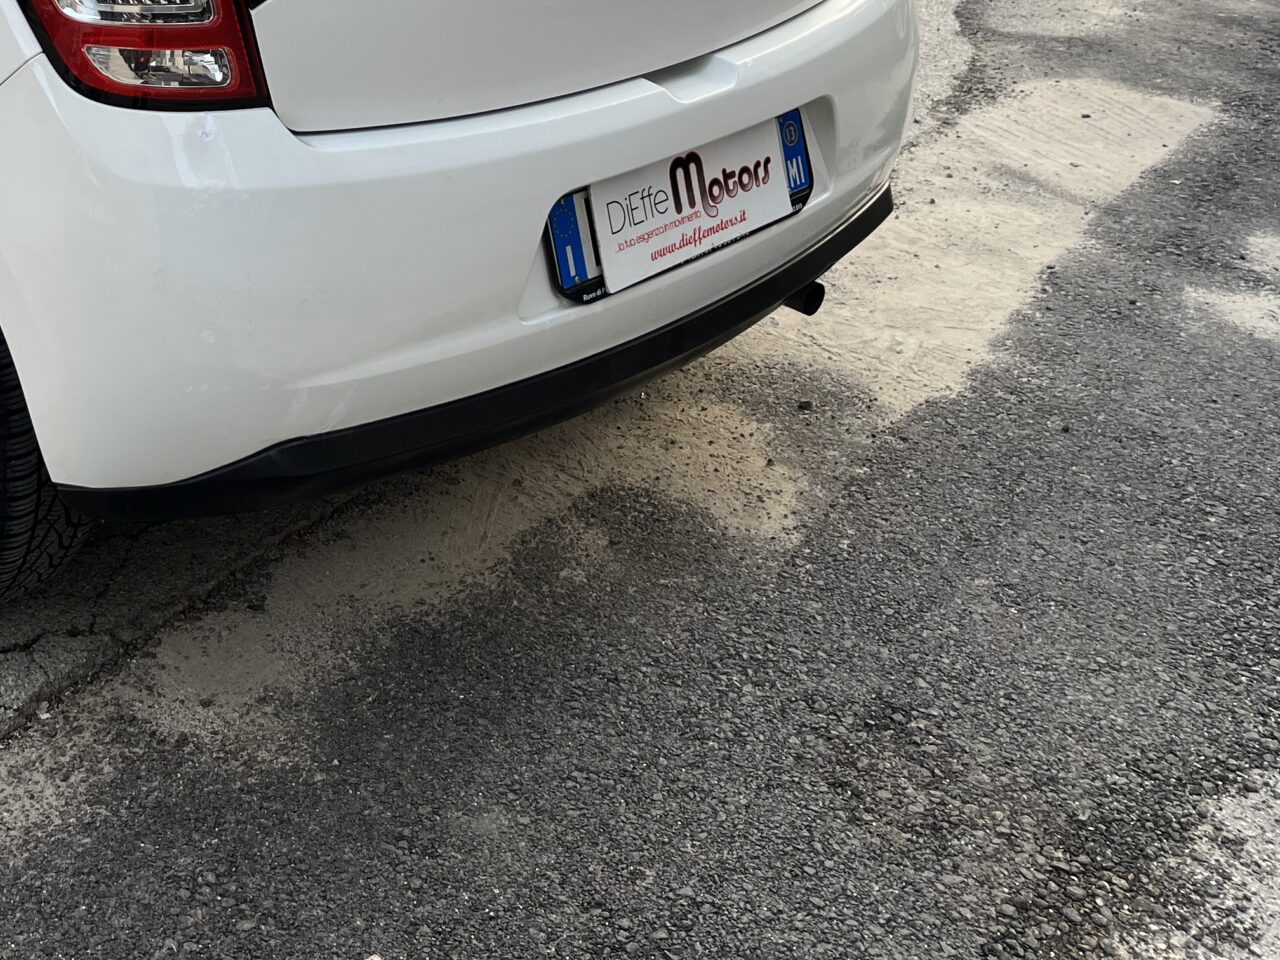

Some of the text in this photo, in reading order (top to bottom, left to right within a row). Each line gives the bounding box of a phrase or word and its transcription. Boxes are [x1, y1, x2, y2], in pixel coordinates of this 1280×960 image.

[606, 150, 772, 235] DiEffe Motors
[786, 155, 806, 188] MI
[650, 208, 748, 262] www.dieffemotors.it
[668, 210, 702, 231] movimento
